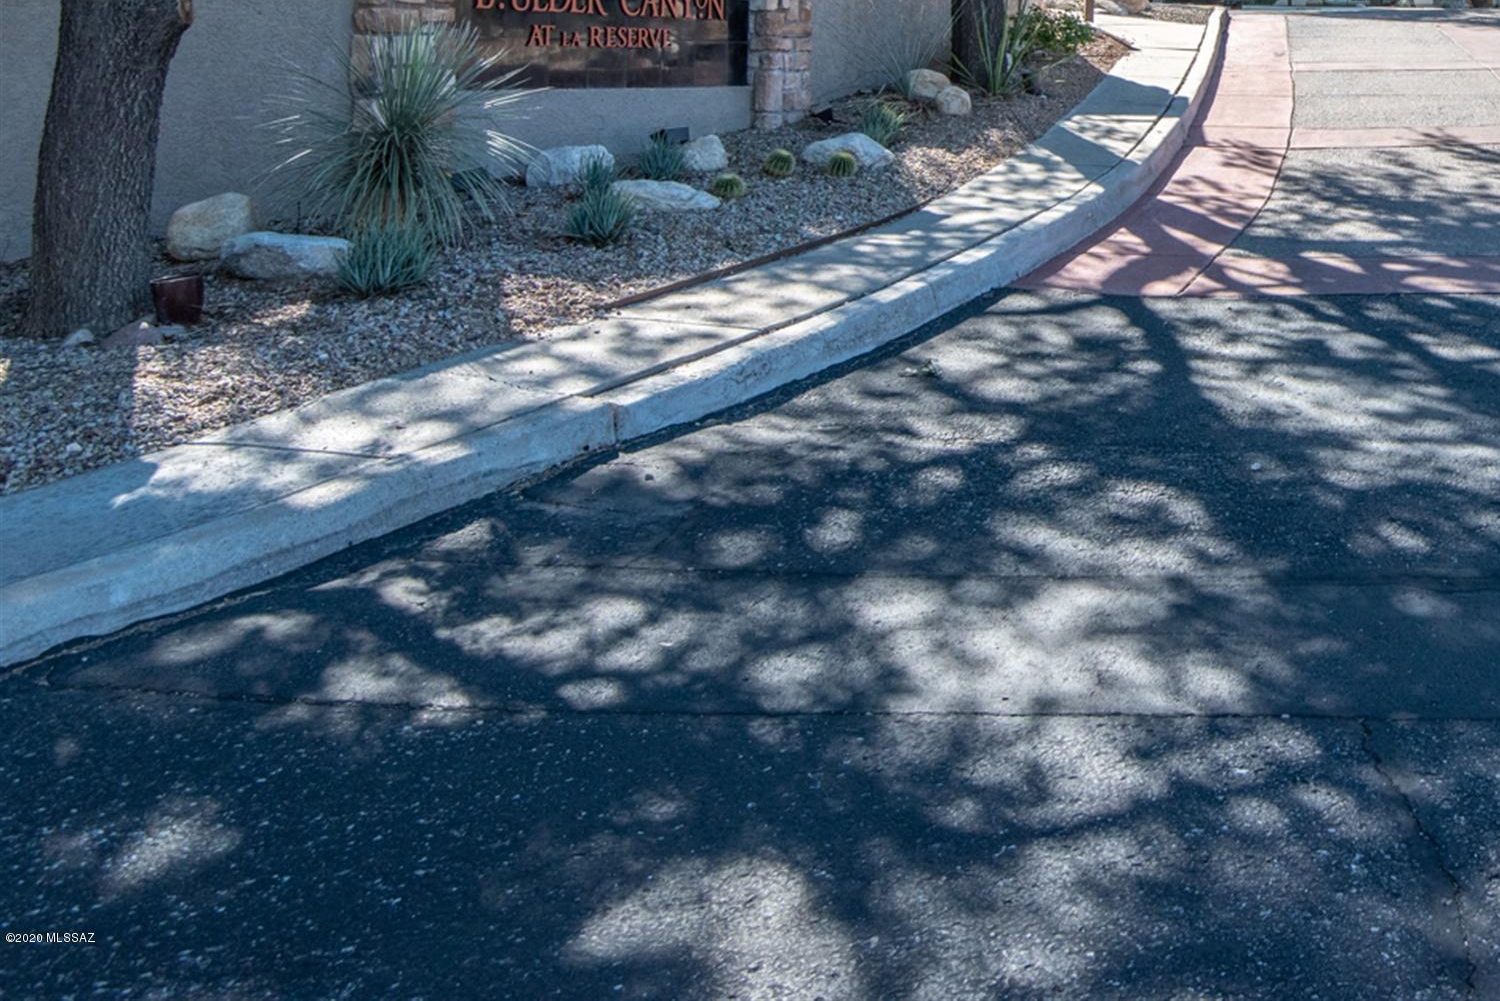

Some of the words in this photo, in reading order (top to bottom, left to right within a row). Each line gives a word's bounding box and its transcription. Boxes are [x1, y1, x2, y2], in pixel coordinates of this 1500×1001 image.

[526, 24, 556, 47] AT
[561, 31, 583, 47] LA
[588, 26, 672, 49] RESERVE
